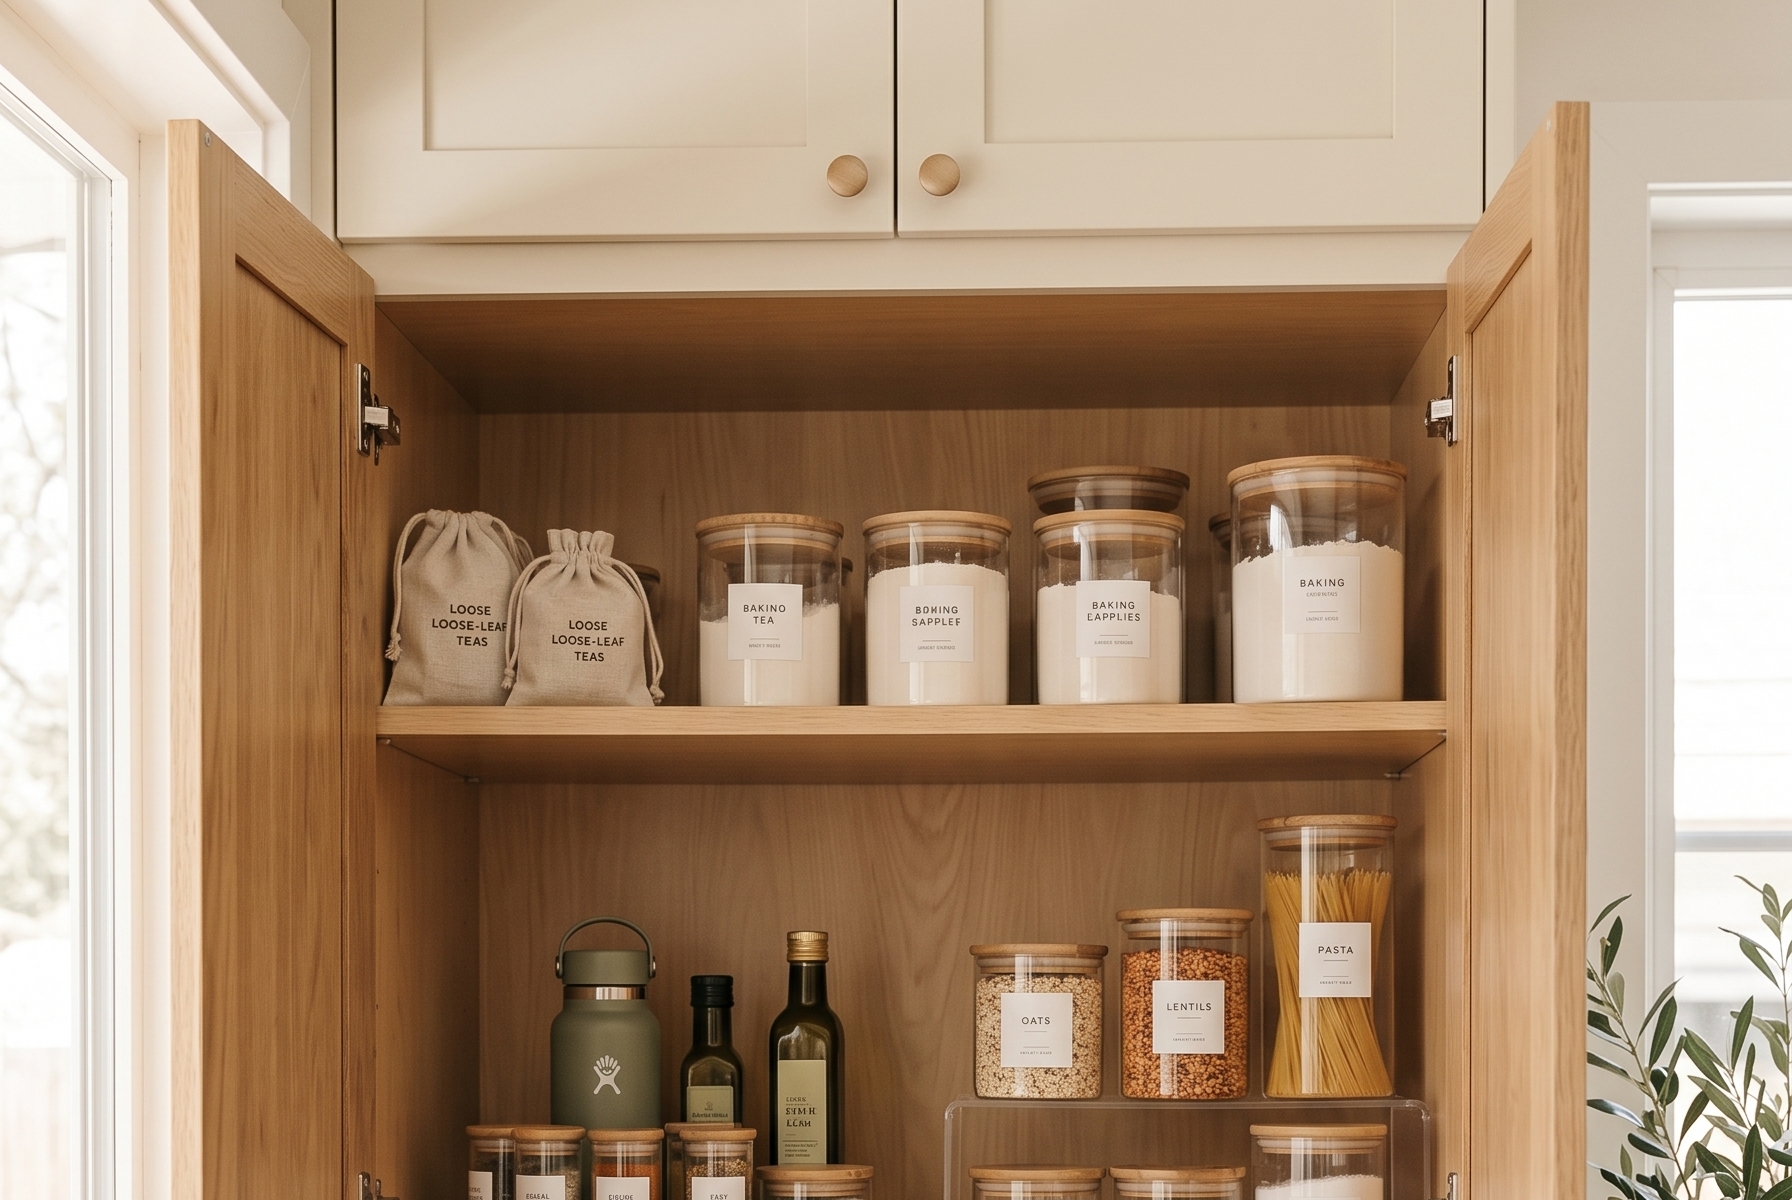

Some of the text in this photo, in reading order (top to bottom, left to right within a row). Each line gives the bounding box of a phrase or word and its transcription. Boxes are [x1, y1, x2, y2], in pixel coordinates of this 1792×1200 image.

[1300, 578, 1345, 588] BAKING
[449, 603, 492, 616] LOOSE
[1092, 601, 1135, 610] BAKING
[431, 618, 508, 632] LOOSE-LEAF
[568, 619, 608, 631] LOOSE
[752, 615, 775, 625] TEA
[456, 635, 488, 647] TEAS
[551, 634, 625, 647] LOOSE-LEAF
[574, 651, 605, 662] TEAS
[1318, 945, 1354, 955] PASTA
[1166, 1002, 1212, 1012] LENTILS
[1021, 1016, 1051, 1025] OATS
